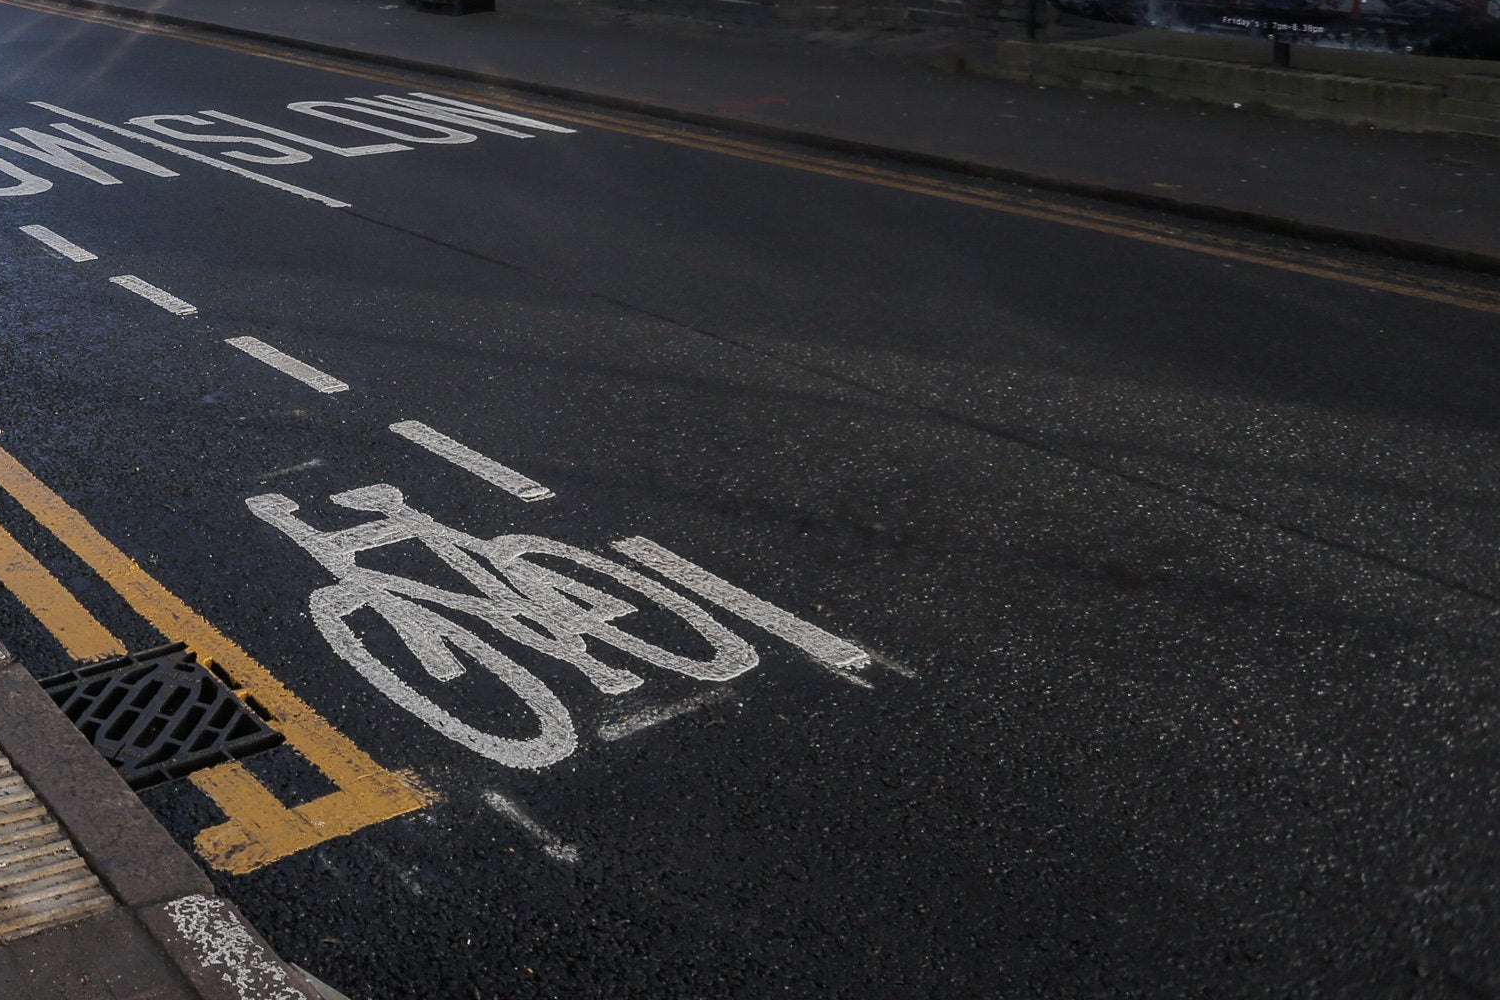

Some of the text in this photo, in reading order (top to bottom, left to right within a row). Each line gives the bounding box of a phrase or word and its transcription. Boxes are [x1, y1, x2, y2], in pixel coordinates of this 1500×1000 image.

[1222, 15, 1260, 28] Friday's
[1272, 20, 1325, 33] 7pm-8.30pm
[125, 92, 577, 165] SLOW
